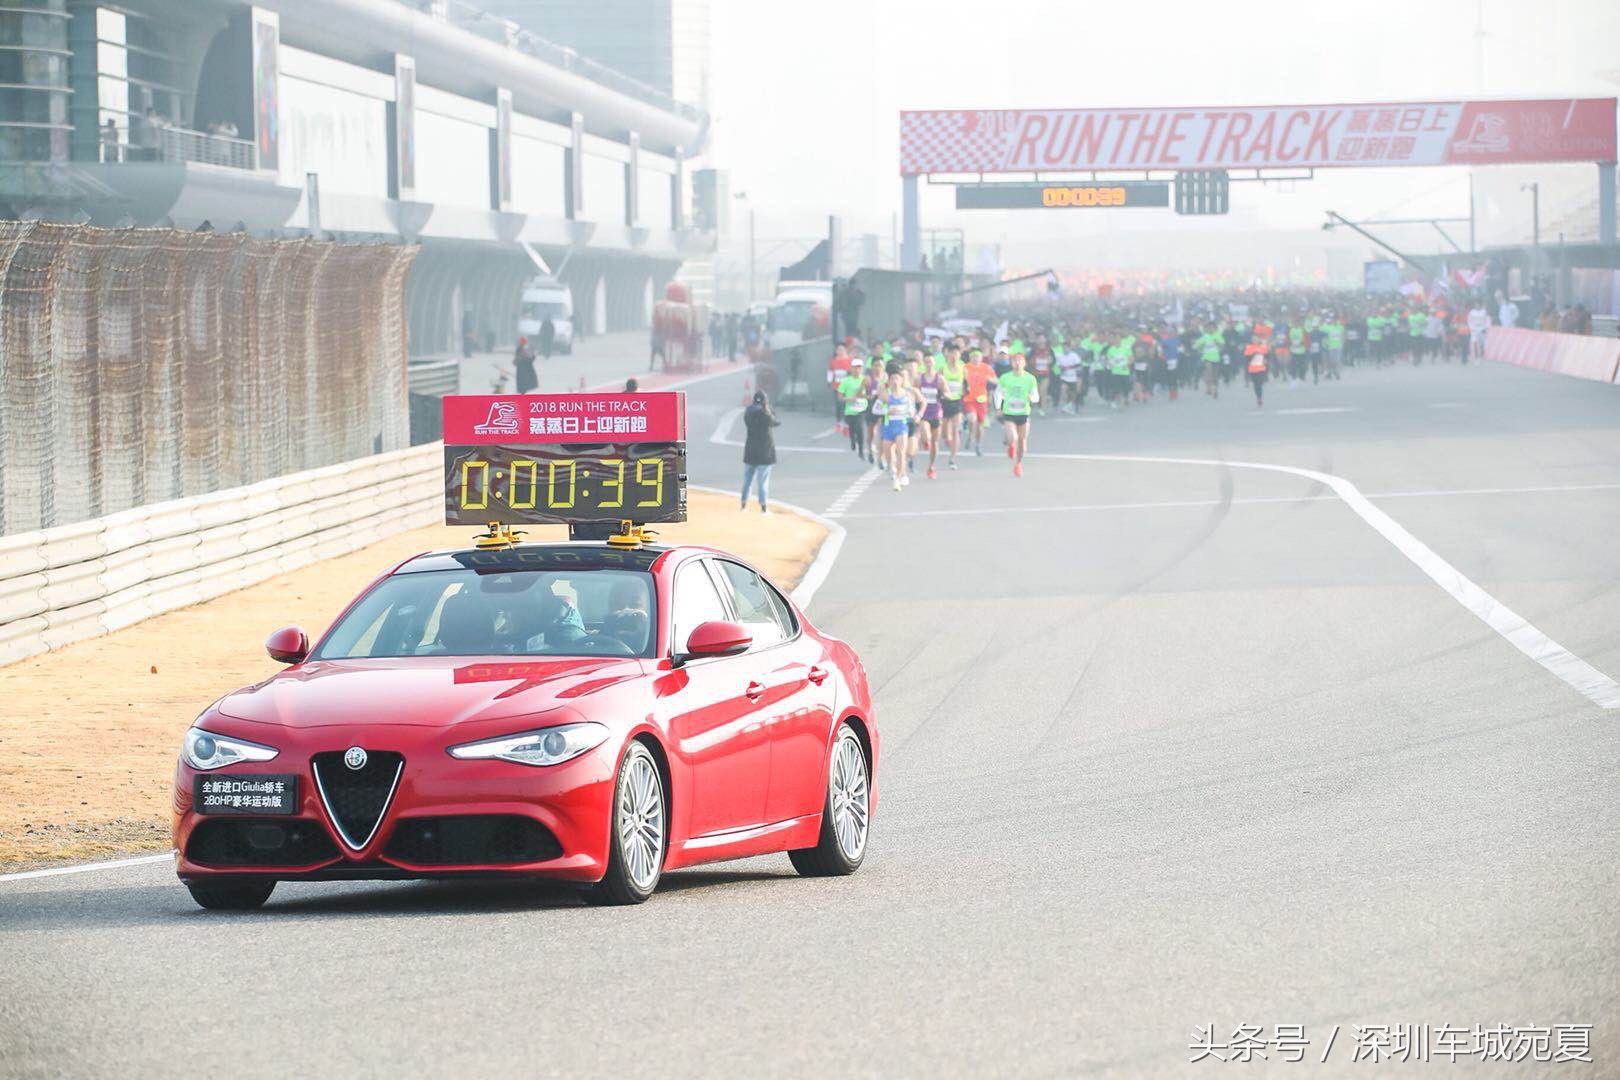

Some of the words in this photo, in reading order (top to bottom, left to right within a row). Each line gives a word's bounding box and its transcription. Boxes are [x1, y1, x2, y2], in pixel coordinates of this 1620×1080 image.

[1197, 110, 1344, 162] TRACK
[530, 402, 557, 413] 2018
[559, 402, 583, 412] RUN
[585, 401, 606, 412] THE
[609, 400, 647, 411] TRACK
[529, 417, 647, 434] 蒸蒸日上迎新跑
[461, 458, 664, 510] 0:00:39
[202, 780, 285, 794] 全新进口Giulia轿车
[203, 795, 282, 808] 280HP豪华运动版
